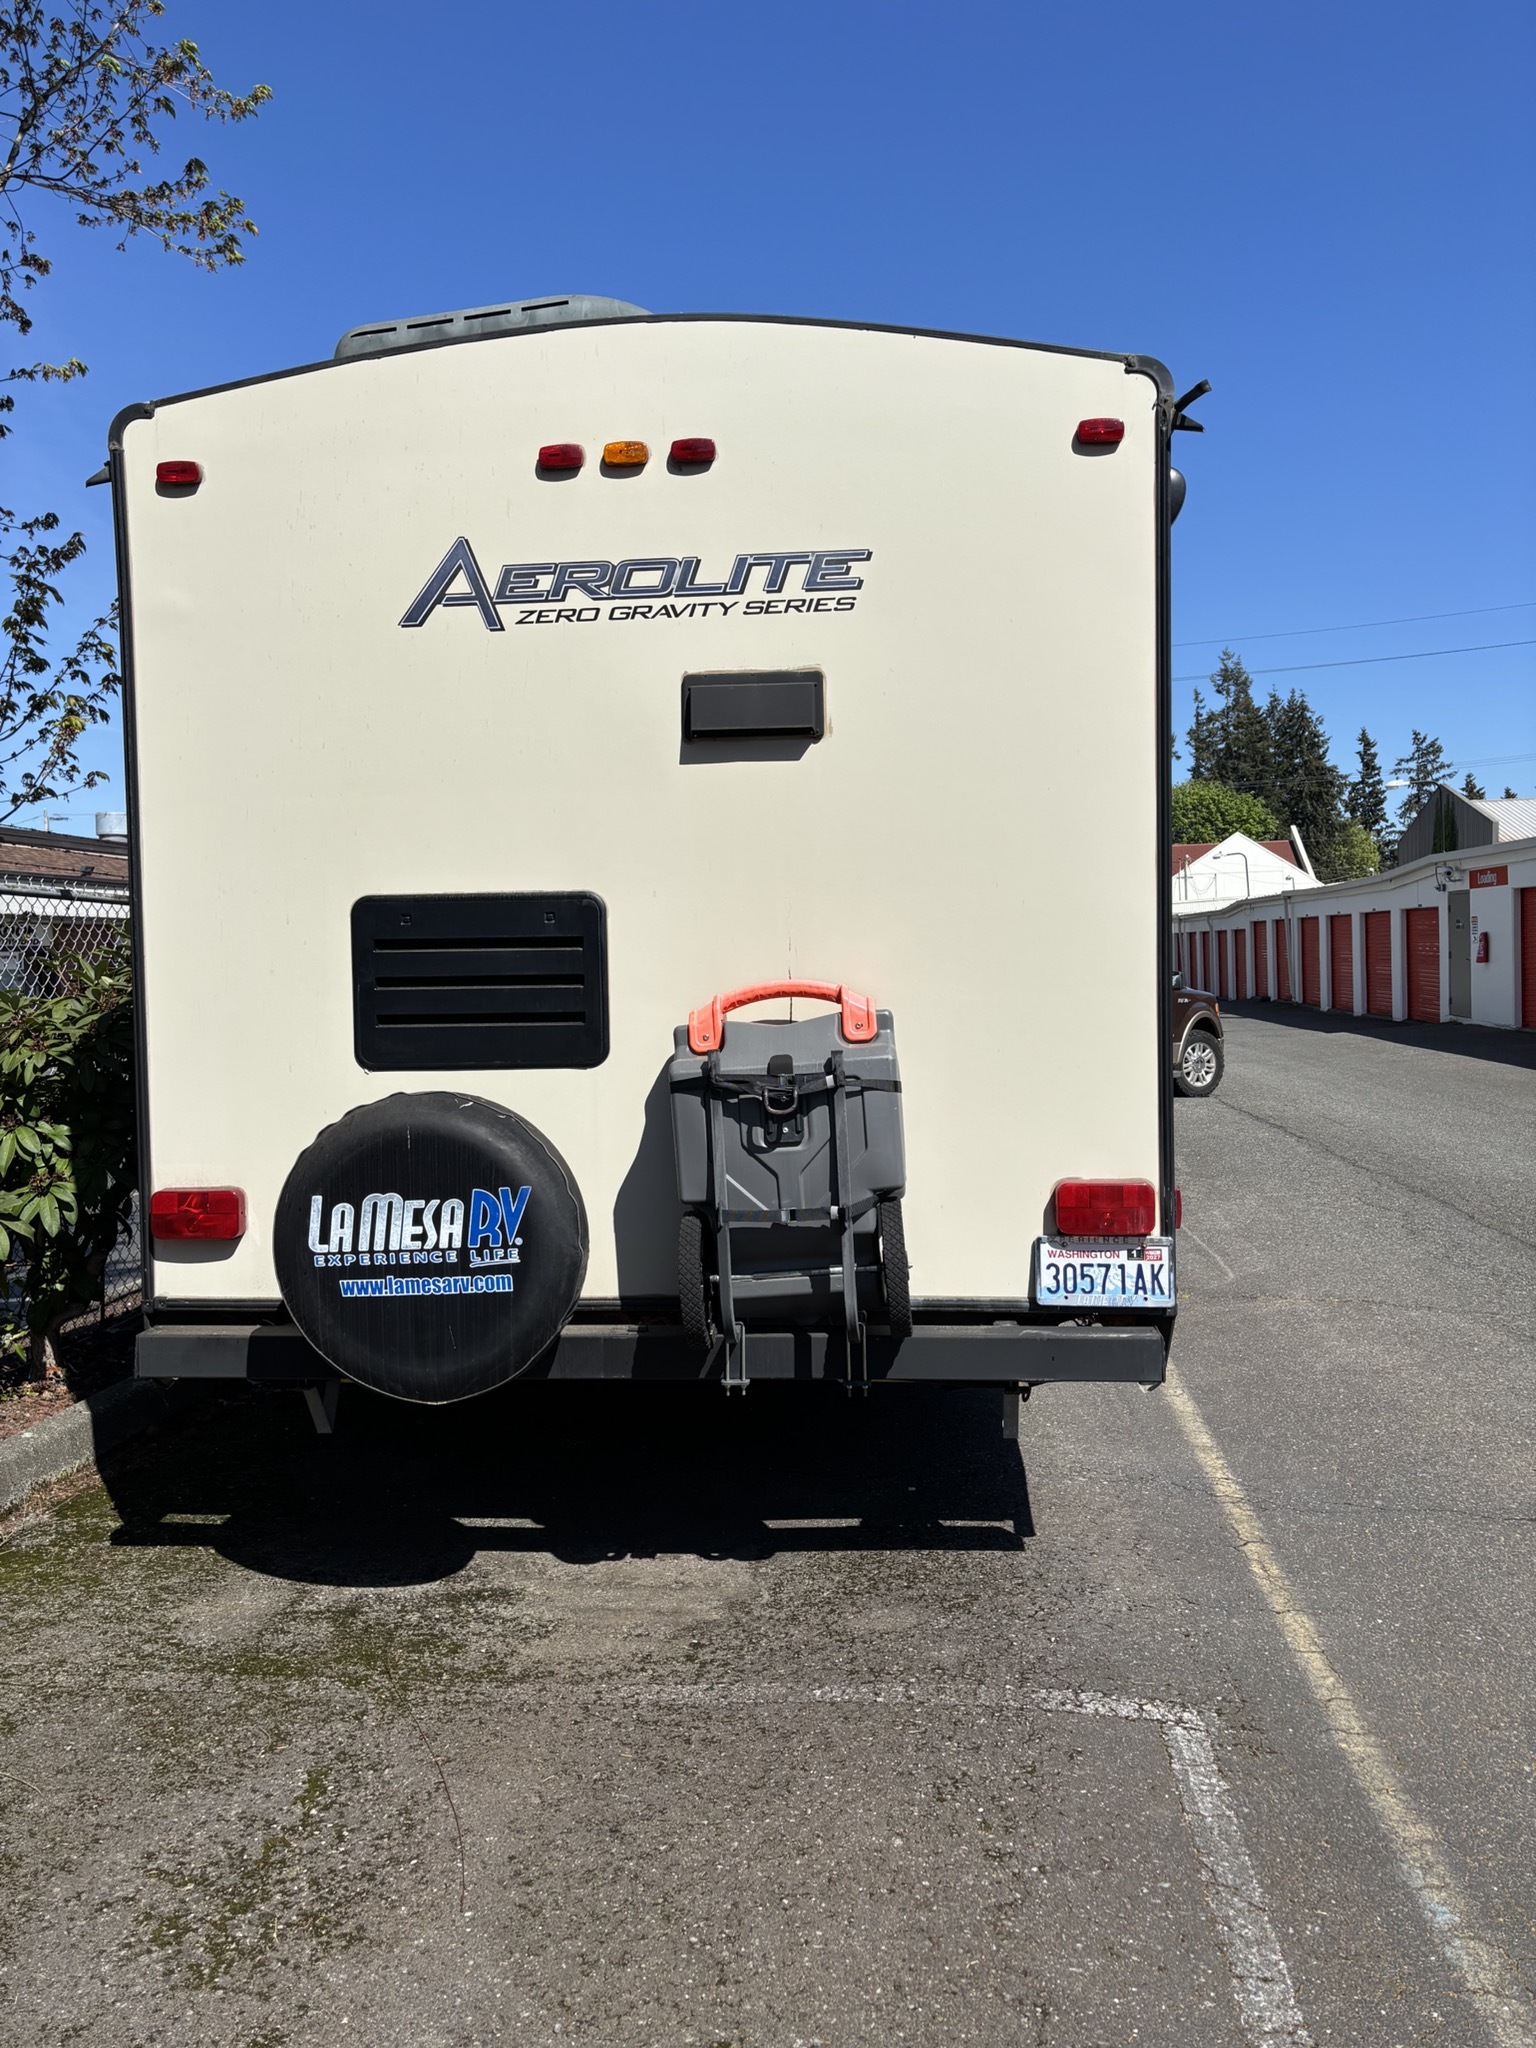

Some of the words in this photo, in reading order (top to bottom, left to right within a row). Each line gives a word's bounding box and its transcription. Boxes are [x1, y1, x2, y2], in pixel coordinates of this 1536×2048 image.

[397, 536, 873, 632] AEROLITE
[515, 607, 601, 625] ZERO
[608, 601, 740, 622] GRAVITY
[742, 596, 858, 616] SERIES
[1477, 870, 1497, 886] Loading
[314, 1250, 458, 1267] EXPERIENCE
[469, 1248, 521, 1263] LIFE
[1047, 1249, 1121, 1259] WASHINGTON
[339, 1273, 514, 1298] www.lamesarv.com
[1045, 1262, 1166, 1296] 30571AK
